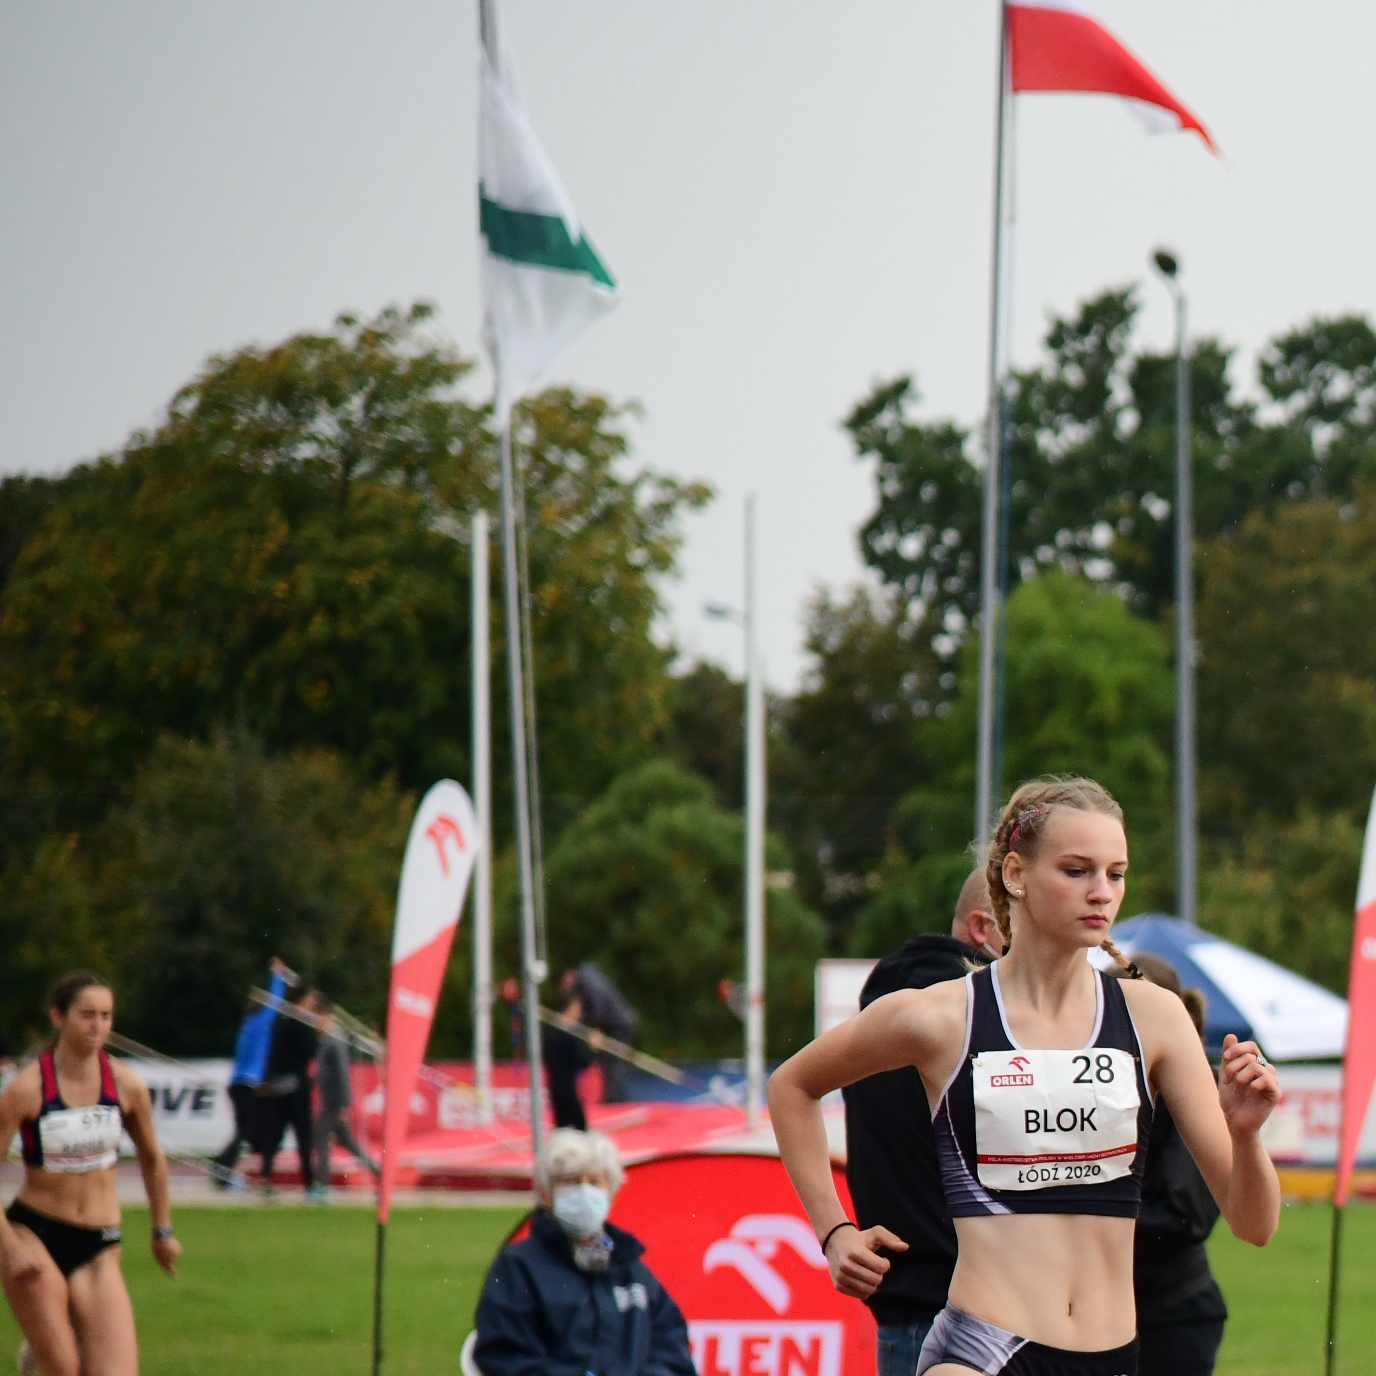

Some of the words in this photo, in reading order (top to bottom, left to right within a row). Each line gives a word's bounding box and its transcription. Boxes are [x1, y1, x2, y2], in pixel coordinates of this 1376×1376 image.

[1071, 1053, 1115, 1084] 28
[992, 1075, 1032, 1086] ORLEN
[153, 1088, 216, 1111] VE
[1024, 1107, 1098, 1134] BLOK
[1017, 1163, 1060, 1184] ŁÓDŹ
[1065, 1164, 1101, 1180] 2020
